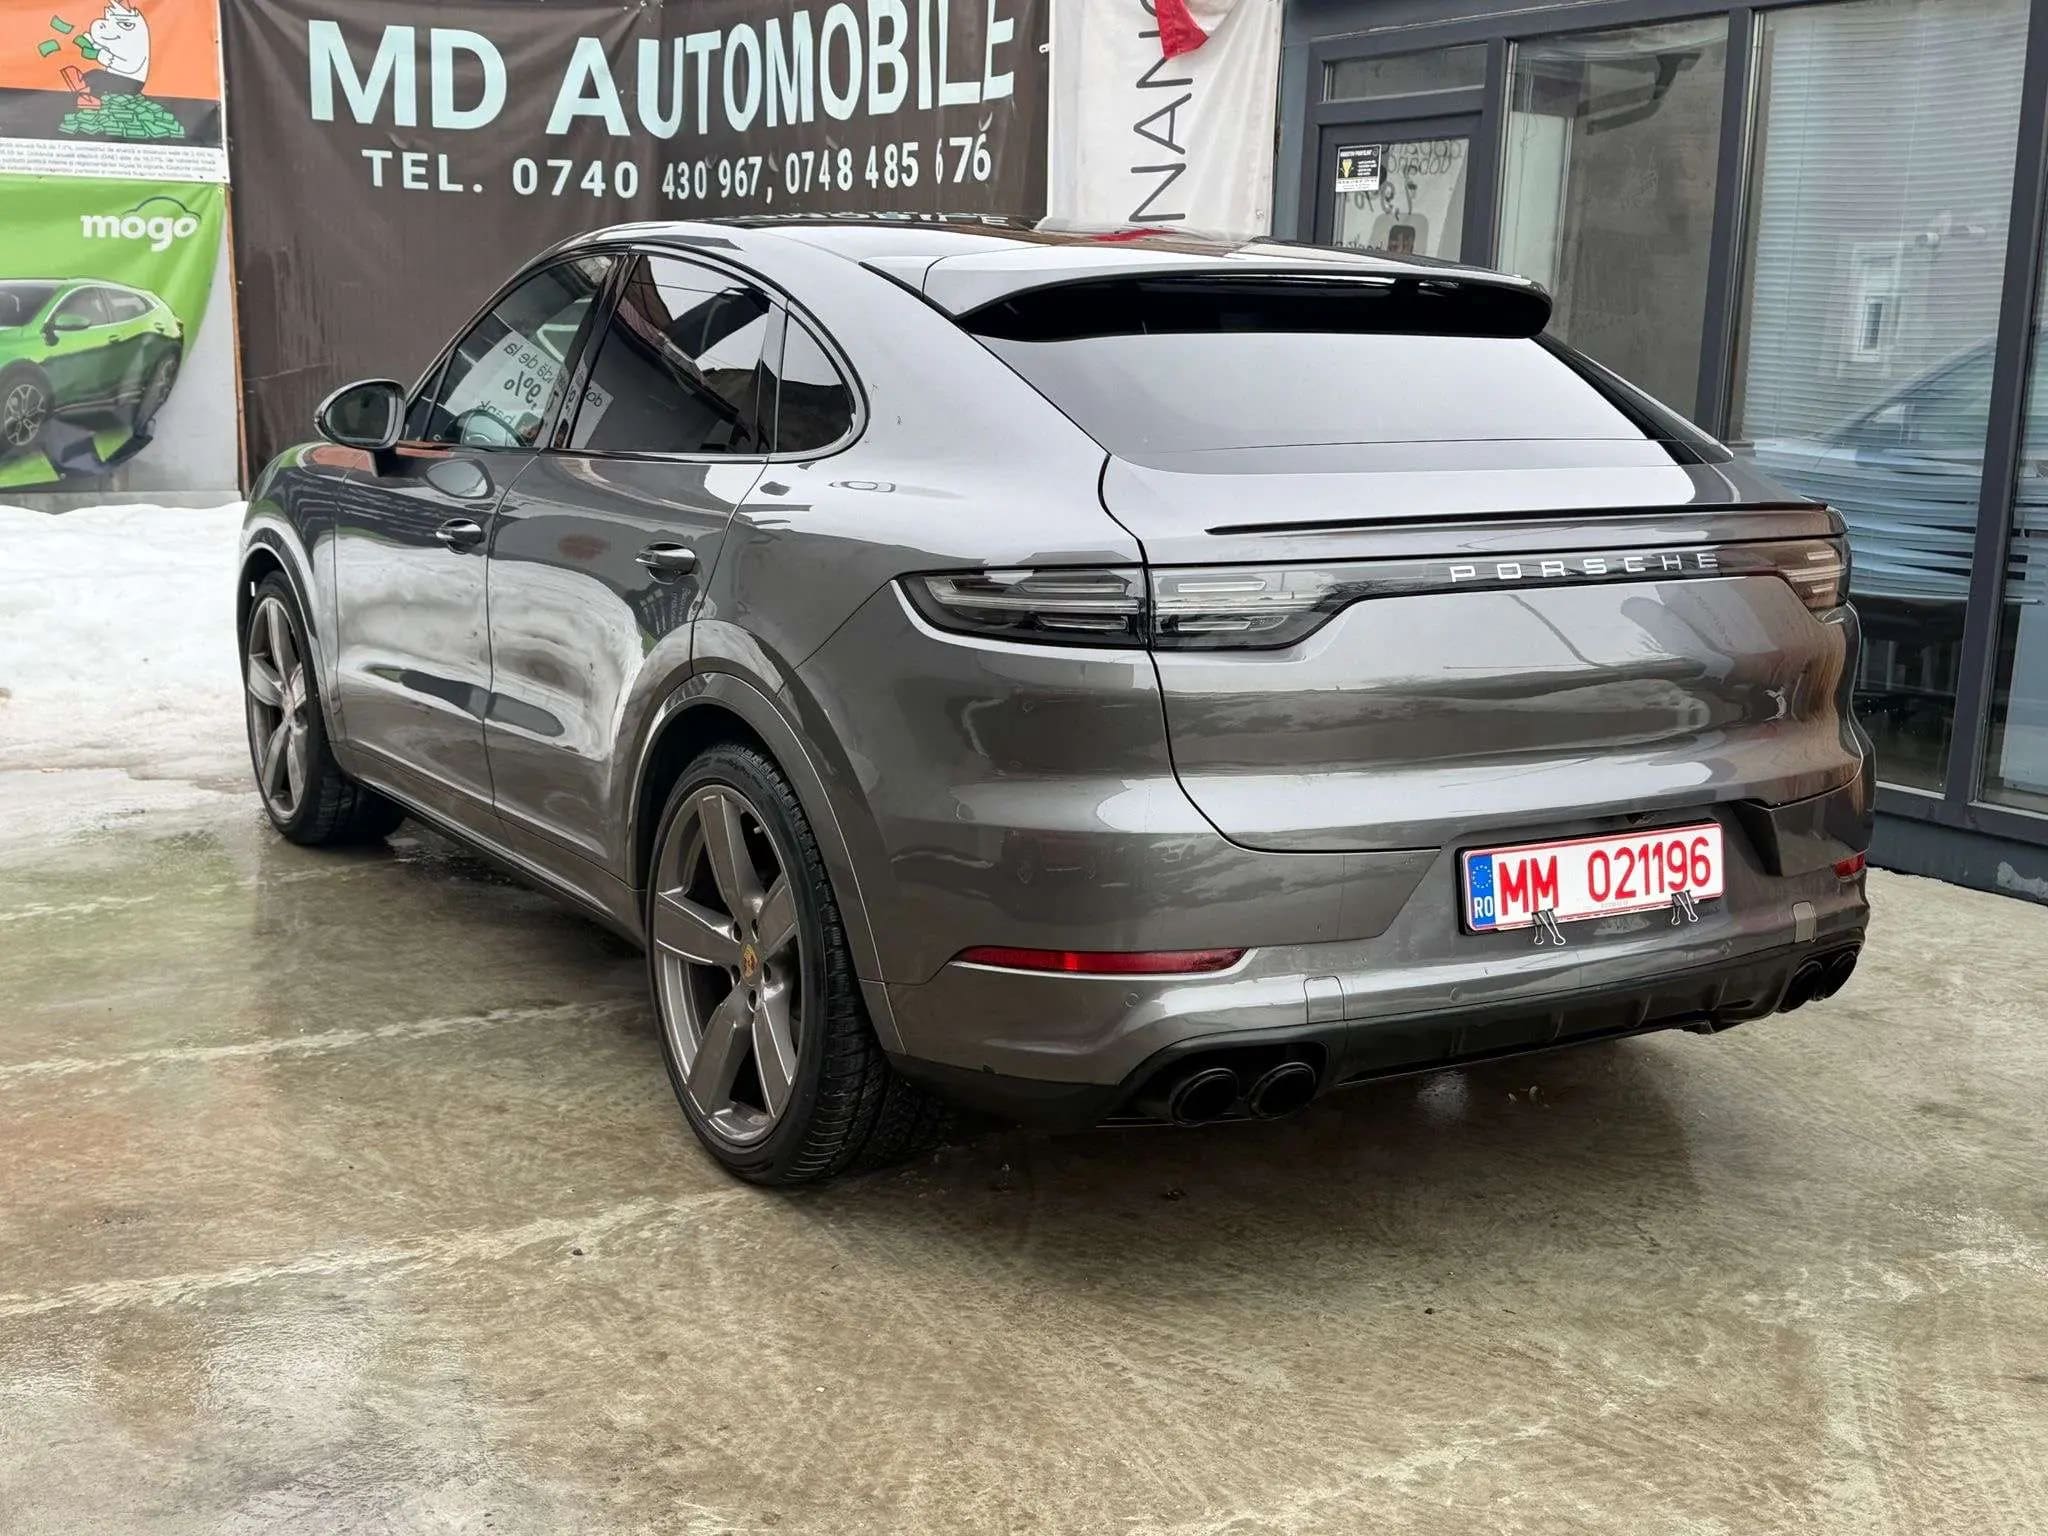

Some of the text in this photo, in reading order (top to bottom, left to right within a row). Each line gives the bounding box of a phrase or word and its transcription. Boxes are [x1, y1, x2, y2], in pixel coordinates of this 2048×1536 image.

[308, 0, 1014, 139] MD AUTOMOBILE
[1129, 0, 1193, 222] NAN
[361, 149, 483, 192] TEL.
[513, 158, 638, 199] 0740
[662, 161, 707, 200] 430
[785, 148, 853, 195] 0748
[865, 142, 918, 189] 485
[935, 133, 991, 183] 676
[80, 214, 198, 251] mogo
[1450, 552, 1718, 582] PORSCHE
[1474, 836, 1711, 919] RO MM 021196
